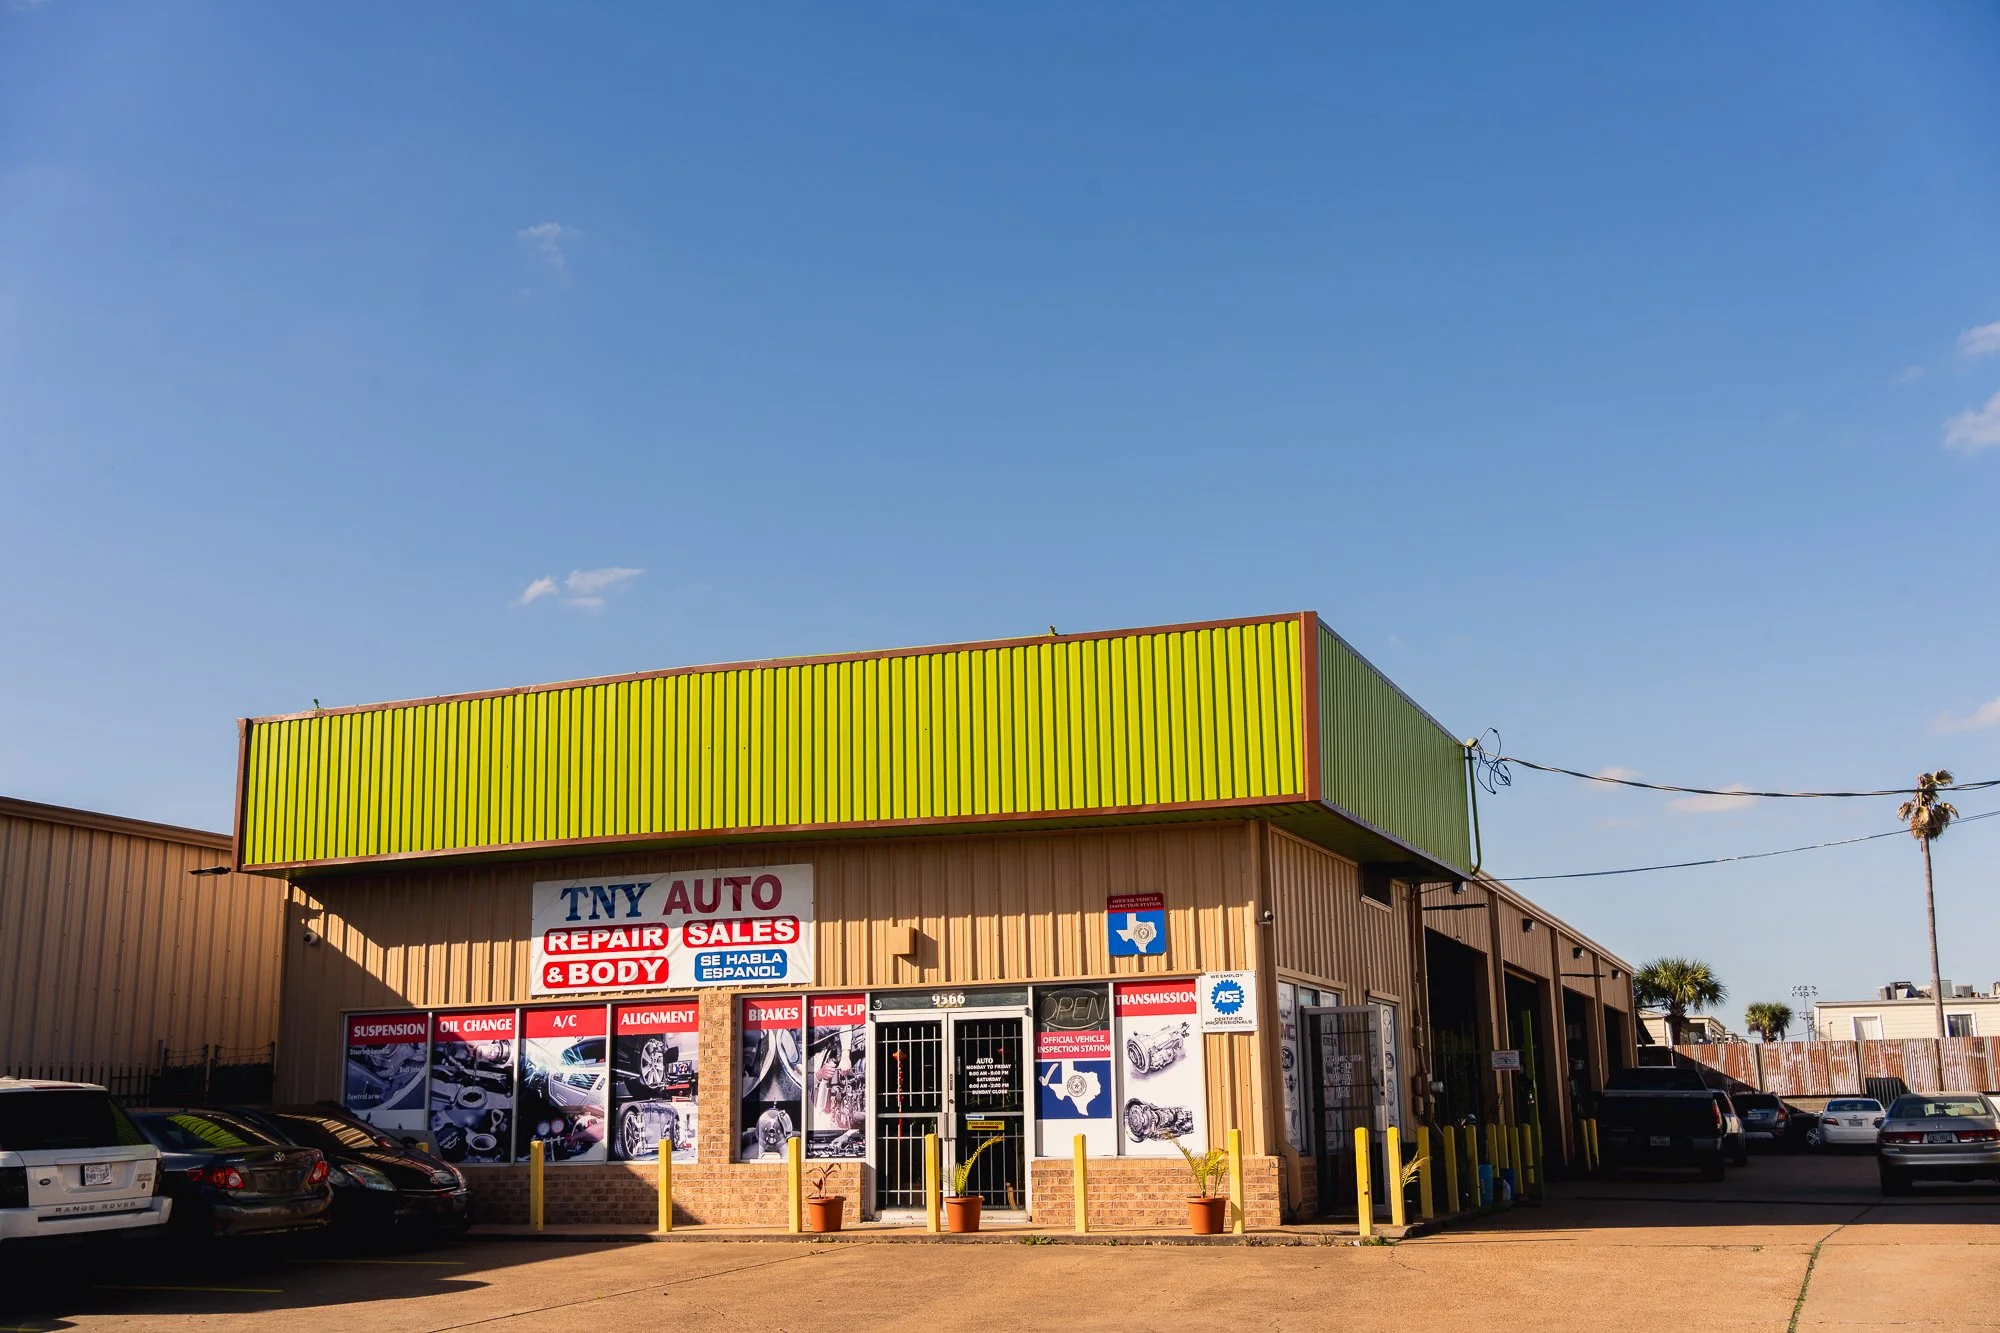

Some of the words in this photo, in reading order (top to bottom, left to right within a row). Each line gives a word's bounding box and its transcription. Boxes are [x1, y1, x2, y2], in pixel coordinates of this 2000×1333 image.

[560, 882, 651, 921] TNY
[662, 874, 782, 916] AUTO
[688, 918, 795, 945] SALES
[550, 927, 664, 951] REPAIR
[700, 954, 720, 966] SE
[726, 952, 783, 965] HABLA
[547, 967, 564, 983] &
[568, 959, 664, 985] BODY
[703, 965, 780, 979] ESPANOL
[931, 992, 965, 1006] 9566
[1114, 992, 1196, 1006] TRANSMISSION
[1214, 990, 1241, 1004] ASE
[748, 1007, 799, 1022] BRAKES
[811, 1004, 865, 1018] TUNE-UP
[1040, 996, 1107, 1021] OPEN
[553, 1014, 577, 1028] A/C
[621, 1010, 696, 1026] ALIGNMENT
[353, 1023, 425, 1037] SUSPENSION
[439, 1020, 460, 1034] OIL
[463, 1018, 513, 1032] CHANGE
[1043, 1036, 1074, 1044] OFFICIAL
[1075, 1035, 1105, 1043] VEHICLE
[1038, 1045, 1080, 1053] INSPECTION
[1081, 1044, 1110, 1052] STATION
[55, 1205, 95, 1213] RANGE
[102, 1201, 136, 1209] ROVER
